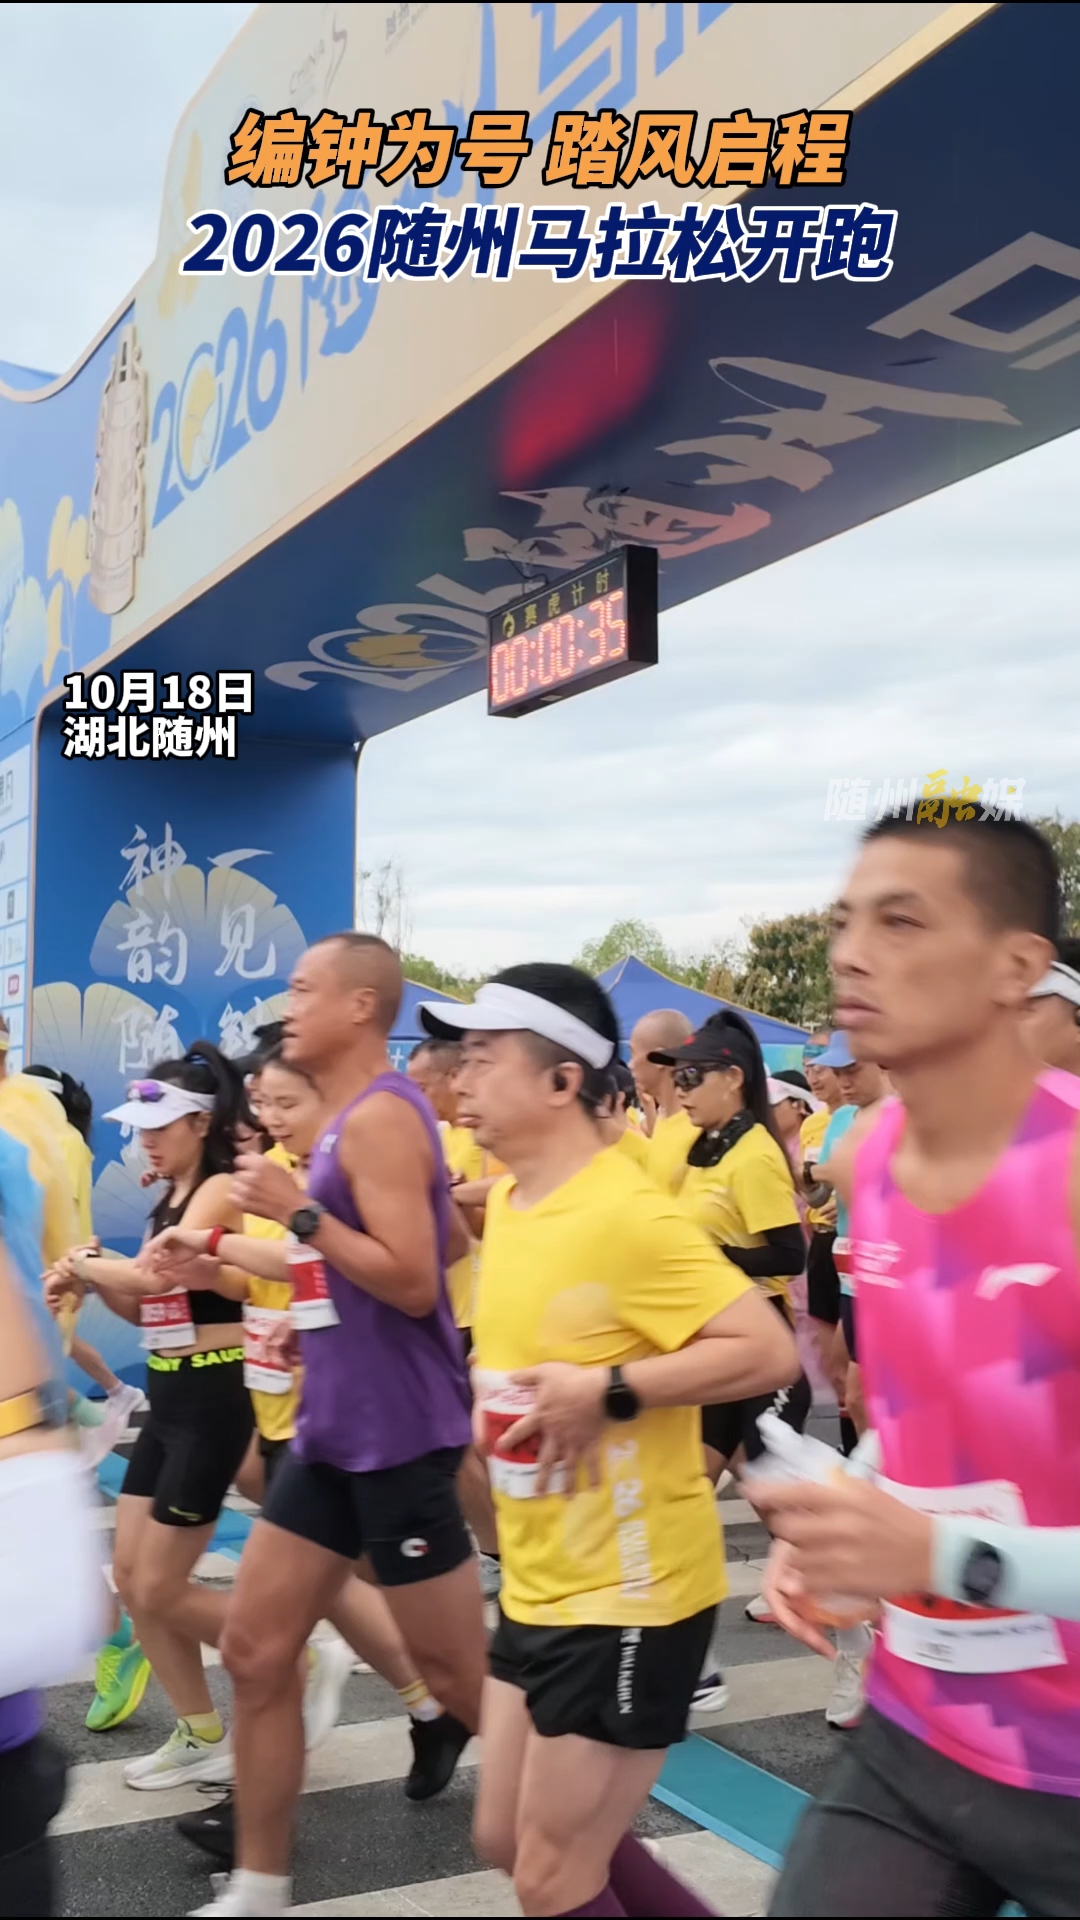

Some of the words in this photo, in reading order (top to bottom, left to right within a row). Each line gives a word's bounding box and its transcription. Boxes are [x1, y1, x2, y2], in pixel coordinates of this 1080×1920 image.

[491, 590, 626, 702] 00:00:35
[525, 568, 609, 627] 赛虎计时
[112, 821, 188, 1157] 神韵随
